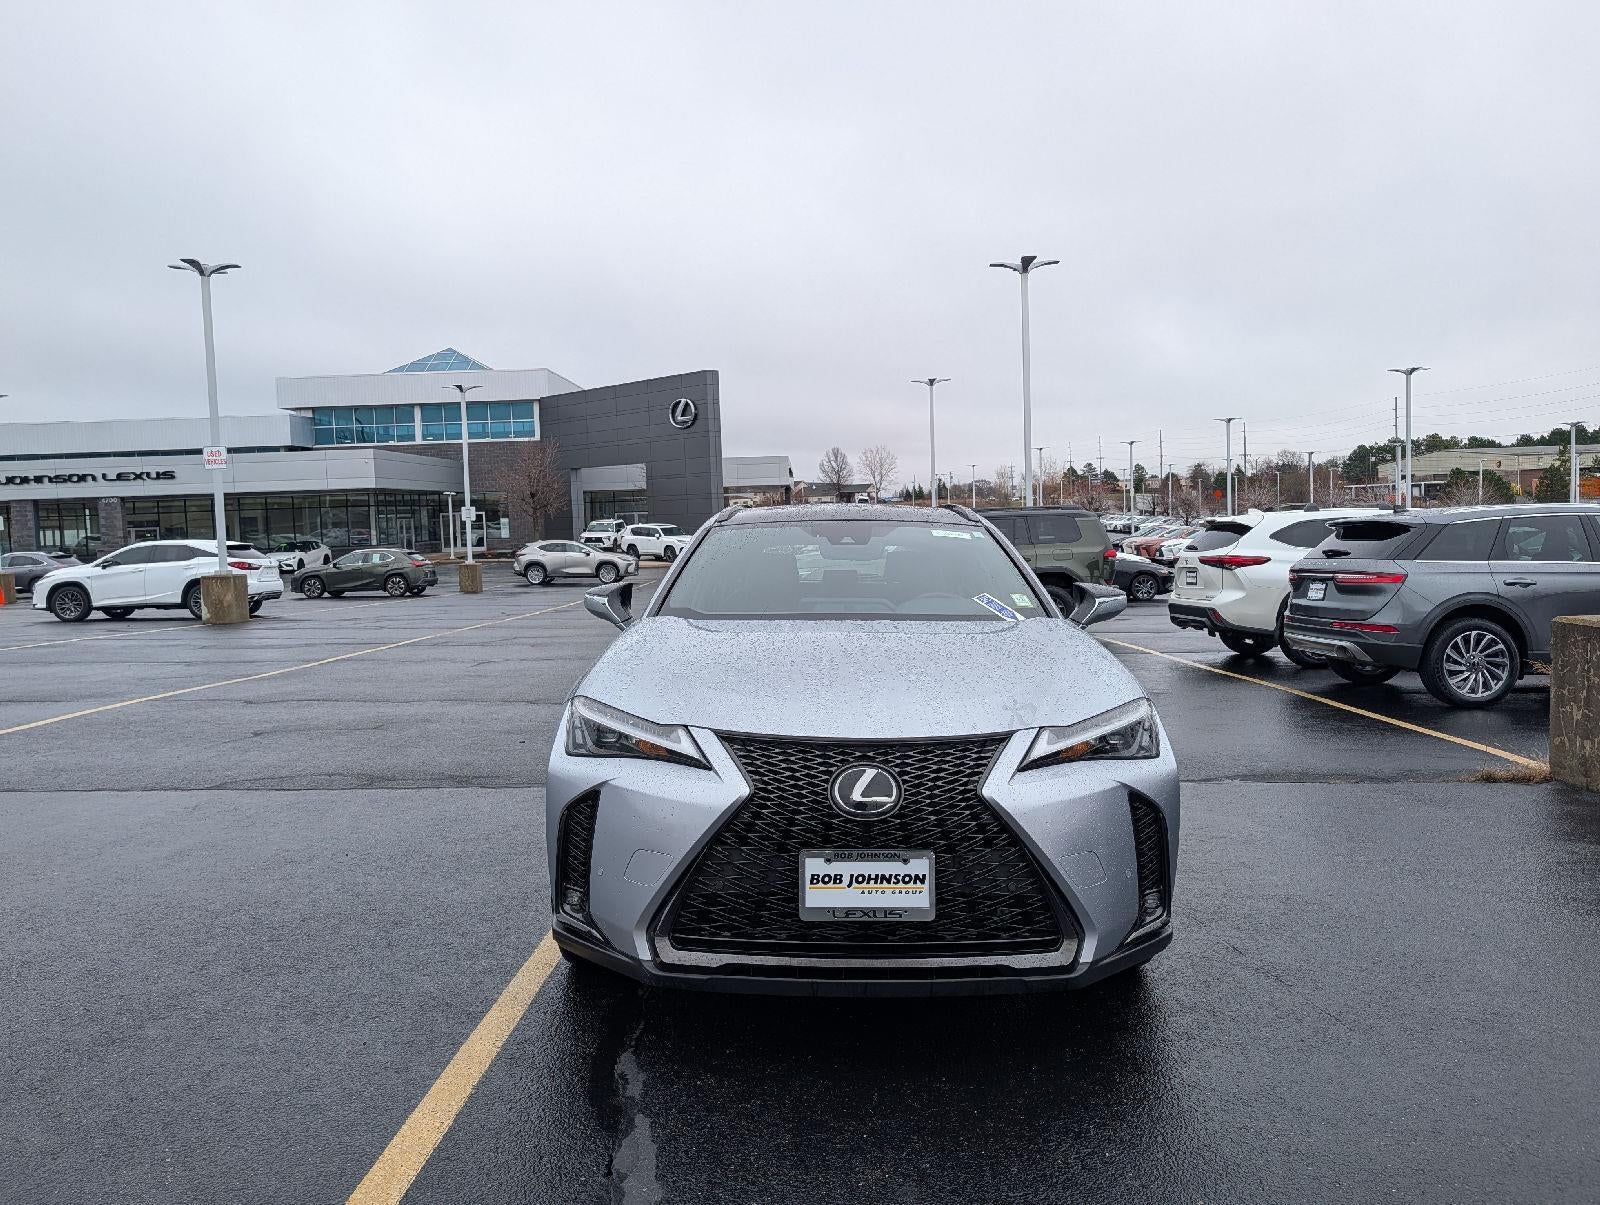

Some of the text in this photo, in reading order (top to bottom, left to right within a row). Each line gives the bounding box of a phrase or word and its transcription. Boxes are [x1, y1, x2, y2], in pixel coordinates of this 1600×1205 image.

[207, 450, 222, 458] USED
[101, 470, 176, 482] LEXUS
[855, 852, 901, 861] JOHNSON
[809, 873, 927, 888] BOB JOHNSON
[832, 909, 903, 919] LEXUS
